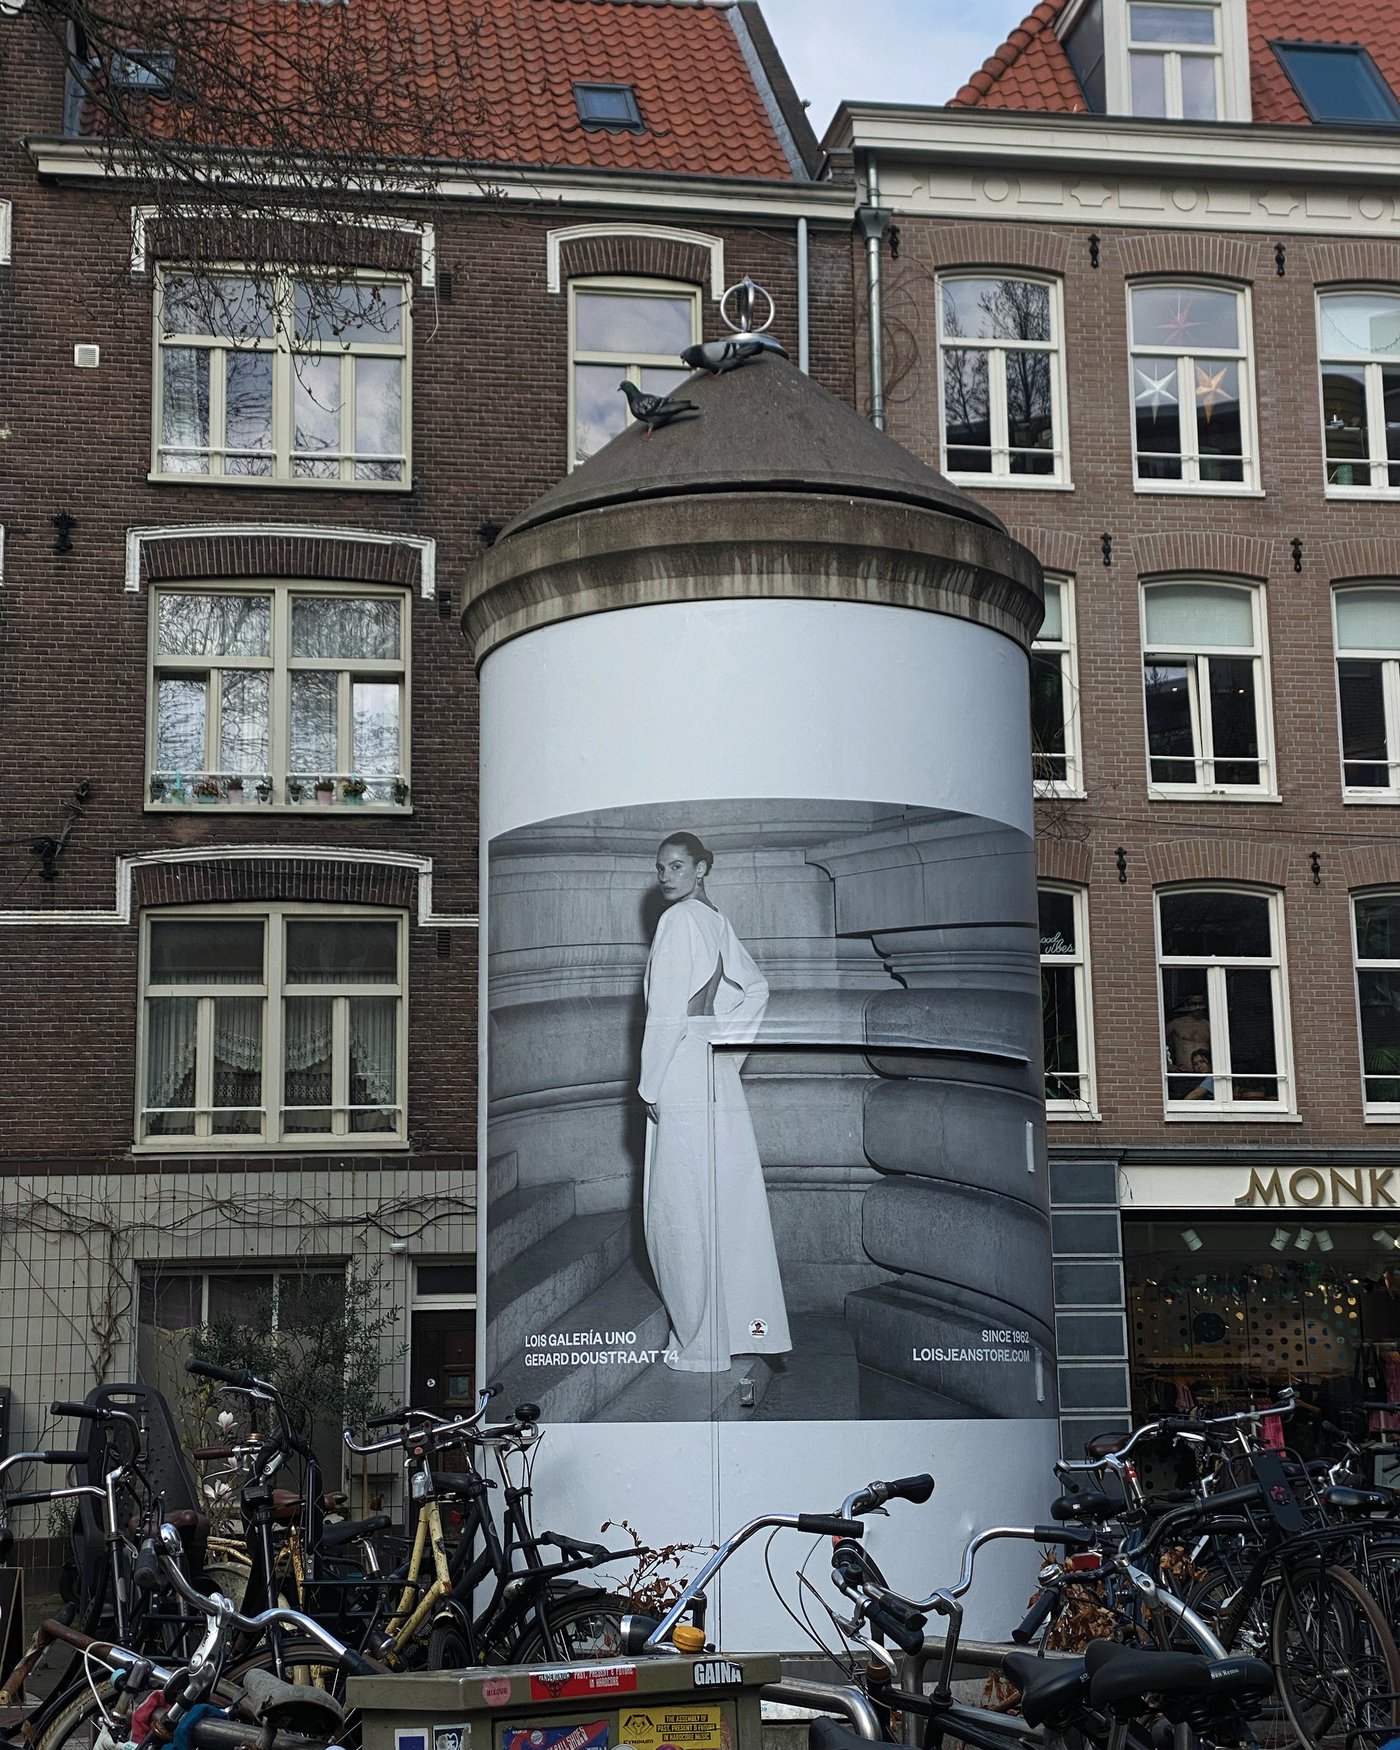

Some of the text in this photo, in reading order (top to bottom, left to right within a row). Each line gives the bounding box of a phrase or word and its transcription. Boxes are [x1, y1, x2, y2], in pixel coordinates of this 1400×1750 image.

[1039, 931, 1061, 943] ood
[1234, 1166, 1397, 1206] MONK
[525, 1329, 637, 1347] LOIS GALERÍA UNO
[982, 1329, 1029, 1343] SINCE 1962
[525, 1350, 679, 1366] GERARD DOUSTRAAT 74
[912, 1348, 1030, 1362] LOISJEANSTORE.COM
[566, 1726, 589, 1750] SHOES
